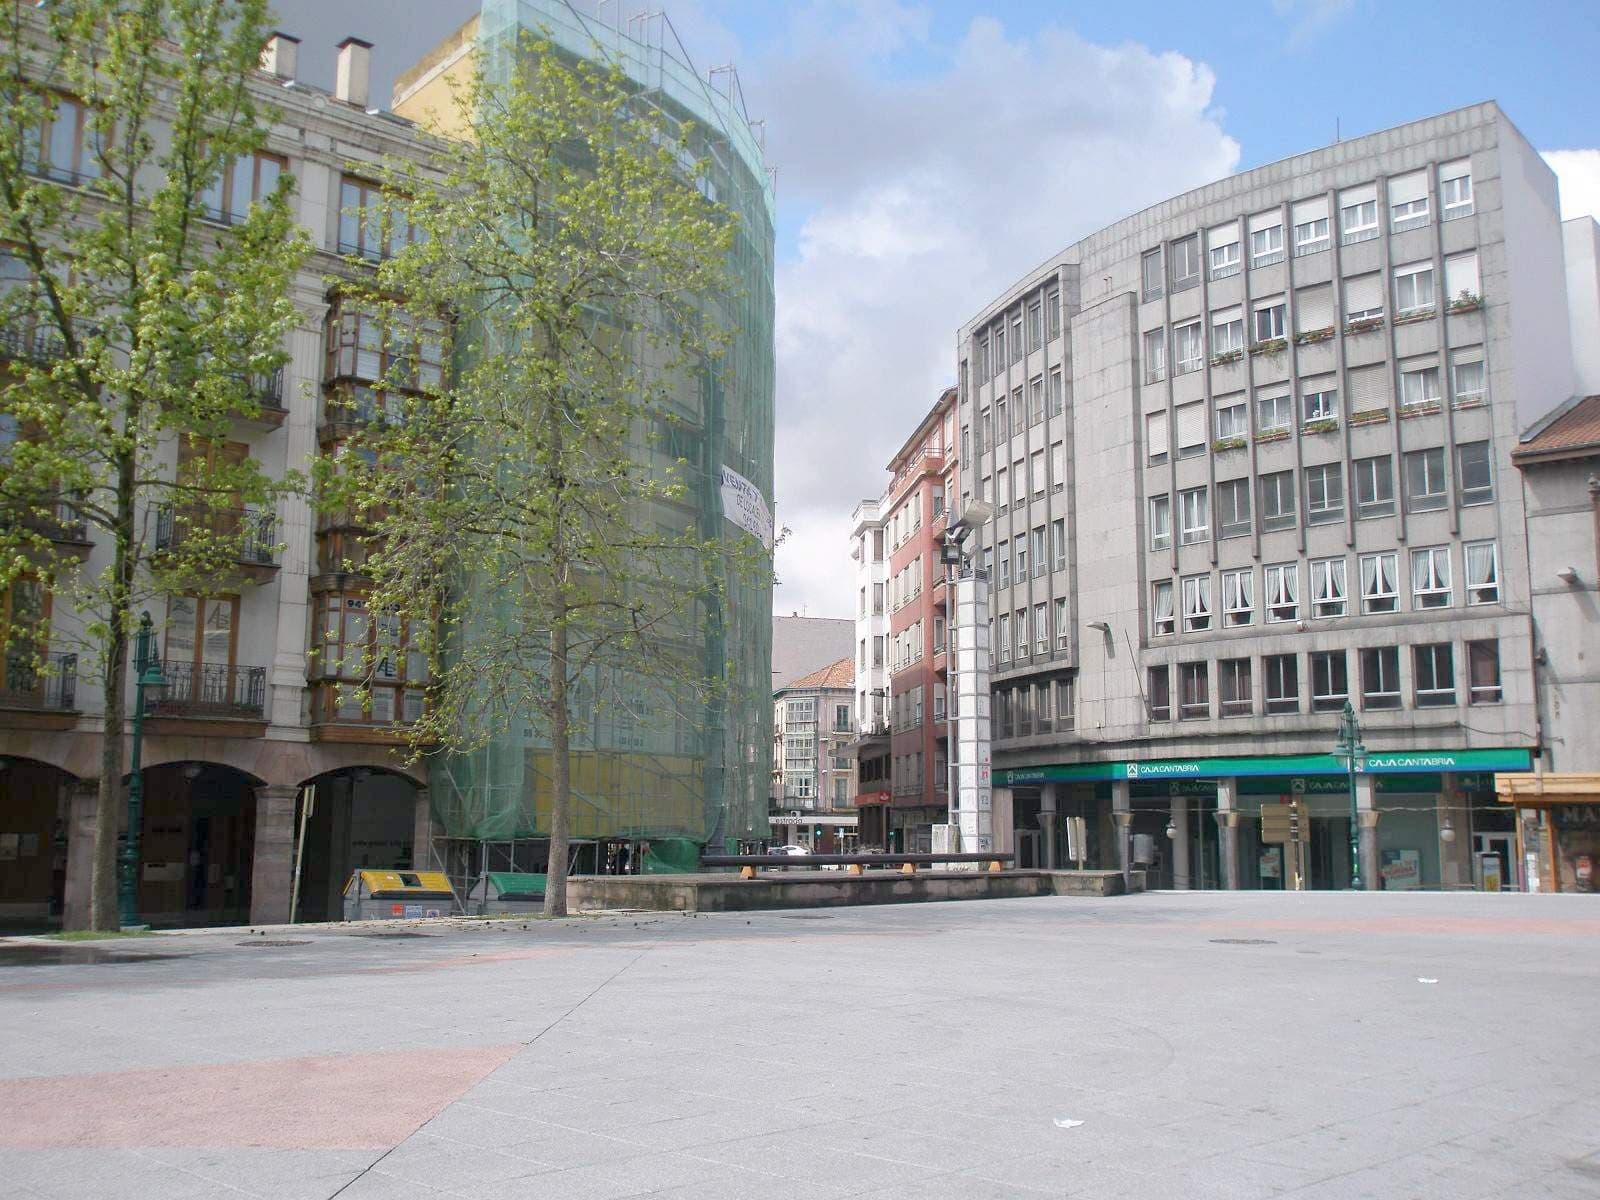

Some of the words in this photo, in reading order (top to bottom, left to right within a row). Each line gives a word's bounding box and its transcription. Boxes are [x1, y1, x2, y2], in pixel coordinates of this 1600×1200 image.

[1369, 759, 1397, 767] CAJA
[1398, 757, 1456, 766] CANTABRIA
[1140, 766, 1159, 774] CAJA
[1159, 764, 1200, 773] CANTABRIA
